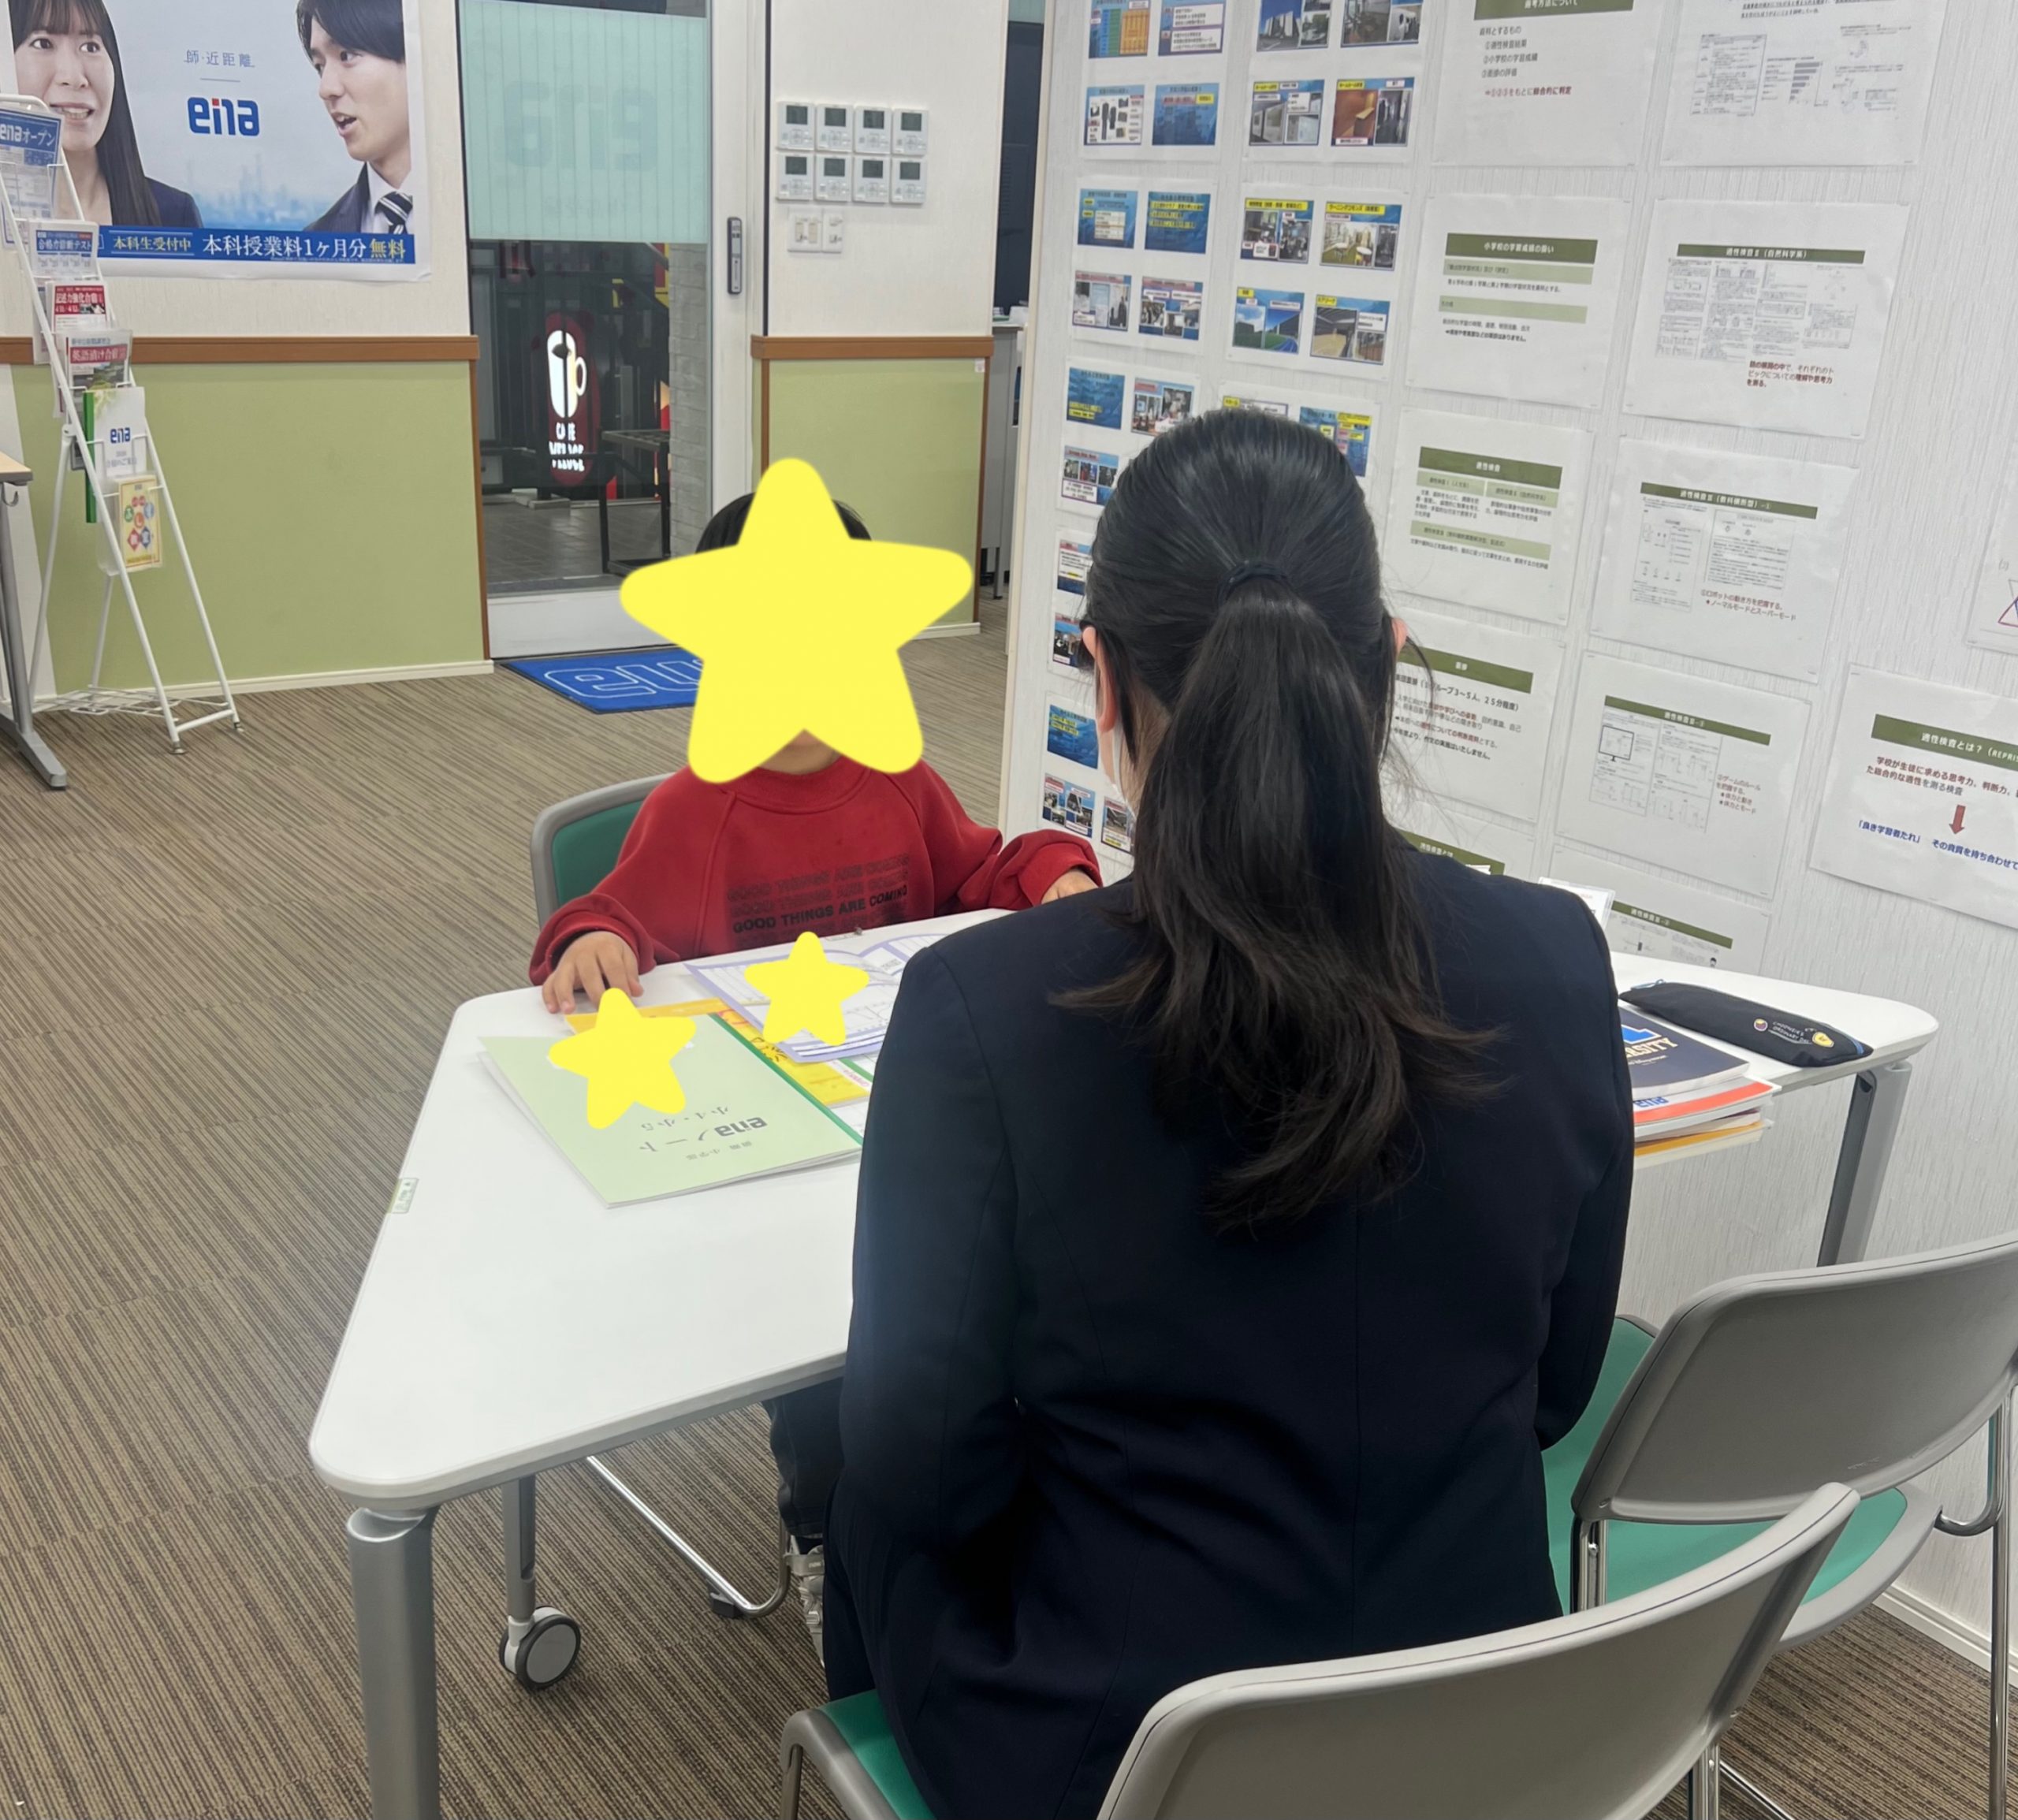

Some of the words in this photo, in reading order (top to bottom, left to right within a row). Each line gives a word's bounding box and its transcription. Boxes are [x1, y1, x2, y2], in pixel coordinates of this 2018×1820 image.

[188, 97, 260, 136] ena
[114, 236, 192, 251] 本科生受付中
[110, 427, 131, 444] ena
[733, 917, 776, 933] GOOD
[781, 905, 833, 925] THINGS
[840, 899, 866, 914] ARE
